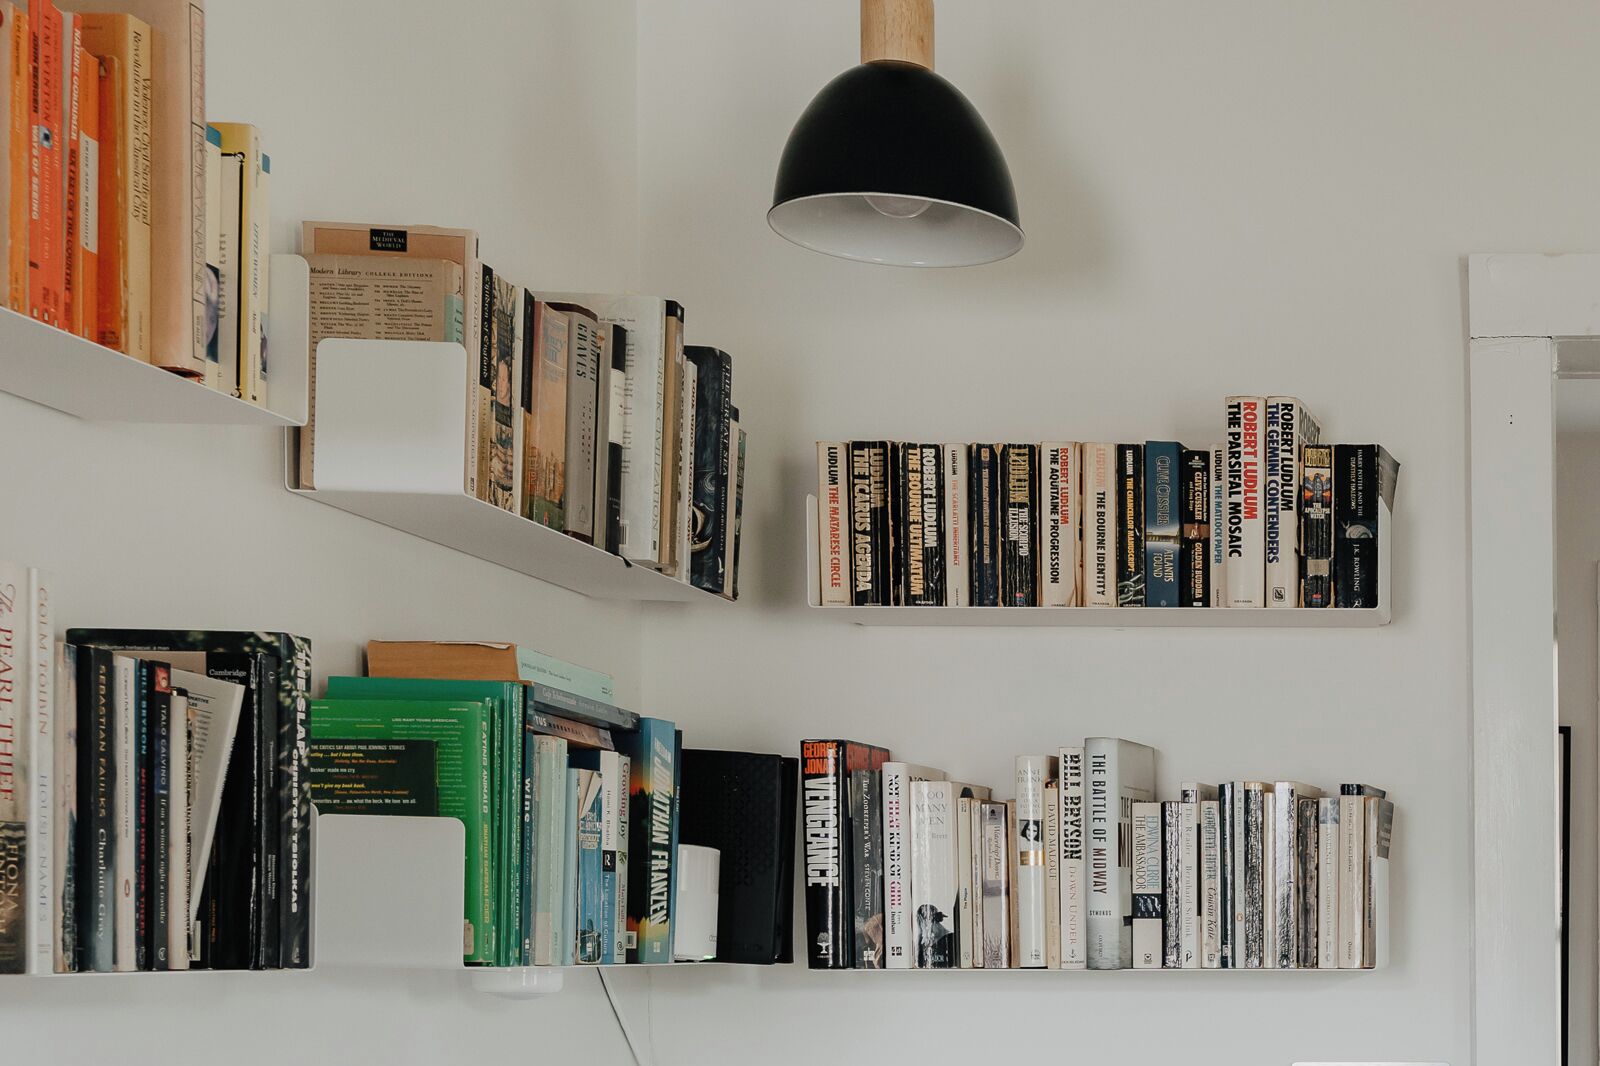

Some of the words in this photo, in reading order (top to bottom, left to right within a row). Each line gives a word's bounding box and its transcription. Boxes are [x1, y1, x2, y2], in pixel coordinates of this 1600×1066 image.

[72, 29, 81, 74] NADINE
[132, 31, 142, 98] Revolution
[132, 111, 142, 132] the
[32, 158, 39, 173] OF
[132, 134, 142, 192] Classical
[141, 132, 151, 160] Civil
[141, 163, 151, 199] Strife
[132, 195, 142, 222] City
[141, 201, 151, 226] and
[310, 267, 333, 275] Modern
[338, 268, 362, 276] Library
[483, 275, 491, 318] Children
[576, 323, 588, 379] GRAVES
[722, 397, 731, 445] GREAT
[1227, 402, 1241, 428] THE
[1243, 401, 1258, 458] ROBERT
[1267, 403, 1279, 427] THE
[1280, 403, 1294, 455] ROBERT
[827, 446, 839, 486] LUDLUM
[854, 449, 870, 475] THE
[908, 449, 921, 470] THE
[923, 449, 936, 496] ROBERT
[1050, 448, 1059, 465] THE
[1060, 447, 1069, 484] ROBERT
[1096, 447, 1106, 488] LUDLUM
[1156, 456, 1171, 485] CLIVE
[1228, 431, 1242, 498] PARSIFAL
[1267, 430, 1279, 477] GEMINI
[829, 486, 840, 505] THE
[870, 448, 885, 508] LUDLUM
[1009, 448, 1029, 503] LUDLUM
[1049, 467, 1059, 517] AQUITAINE
[1194, 472, 1202, 491] CLIVE
[1243, 461, 1258, 520] LUDLUM
[1280, 457, 1294, 511] LUDLUM
[855, 479, 871, 532] ICARUS
[909, 473, 922, 522] BOURNE
[1019, 508, 1028, 524] THE
[1060, 487, 1069, 524] LUDLUM
[1096, 491, 1106, 510] THE
[1156, 485, 1171, 525] CUSSLER
[1194, 492, 1202, 520] CUSSLER
[829, 506, 841, 555] MATARESE
[924, 498, 937, 548] LUDLUM
[1009, 508, 1019, 541] ILLUSION
[1019, 525, 1029, 556] SCORPIO
[1096, 511, 1106, 550] BOURNE
[1228, 501, 1242, 558] MOSAIC
[1267, 480, 1279, 564] CONTENDERS
[855, 534, 872, 592] AGENDA
[910, 524, 923, 595] ULTIMATUM
[1050, 519, 1060, 584] PROGRESSION
[1153, 552, 1163, 577] FOUND
[1164, 549, 1174, 582] ATLANTIS
[1194, 543, 1203, 569] GOLDEN
[830, 557, 841, 588] CIRCLE
[1096, 552, 1106, 596] IDENTITY
[1194, 570, 1202, 598] BUDDHA
[1352, 557, 1360, 591] ROWLING
[0, 626, 14, 710] PEARL
[297, 650, 307, 690] THE
[98, 664, 107, 751] SEBASTIAN
[295, 697, 307, 756] SLAP
[0, 717, 15, 802] THIEF
[481, 721, 489, 765] EATING
[803, 742, 838, 758] GEORGE
[804, 758, 837, 774] JONAS
[1062, 753, 1082, 790] BILL
[1092, 754, 1107, 775] THE
[98, 757, 106, 817] FAULKS
[481, 768, 489, 814] ANIMALS
[618, 762, 630, 817] Growing
[653, 756, 670, 844] JONATHAN
[887, 774, 900, 798] NOT
[1092, 780, 1107, 823] BATTLE
[888, 799, 901, 830] THAT
[915, 803, 948, 813] MANY
[1047, 803, 1056, 836] DAVID
[1063, 795, 1082, 861] BRYSON
[1135, 815, 1146, 831] THE
[618, 819, 628, 840] Joy
[804, 776, 839, 887] VENGEANCE
[888, 832, 902, 861] KIND
[1092, 829, 1107, 843] OF
[1146, 816, 1159, 855] EDWINA
[7, 844, 19, 911] FIONA
[97, 828, 107, 898] Charlotte
[291, 833, 299, 913] TSIOLKAS
[889, 863, 901, 880] OF
[1048, 838, 1057, 881] MALOUF
[1092, 848, 1107, 894] MIDWAY
[1135, 833, 1147, 890] AMBASSADOR
[1146, 857, 1159, 889] CURRIE
[40, 856, 48, 921] NAMES
[650, 850, 669, 926] FRANZEN
[1207, 887, 1217, 917] Cousin
[96, 903, 107, 940] Gray
[1069, 904, 1077, 945] UNDER
[1207, 919, 1217, 940] Kate
